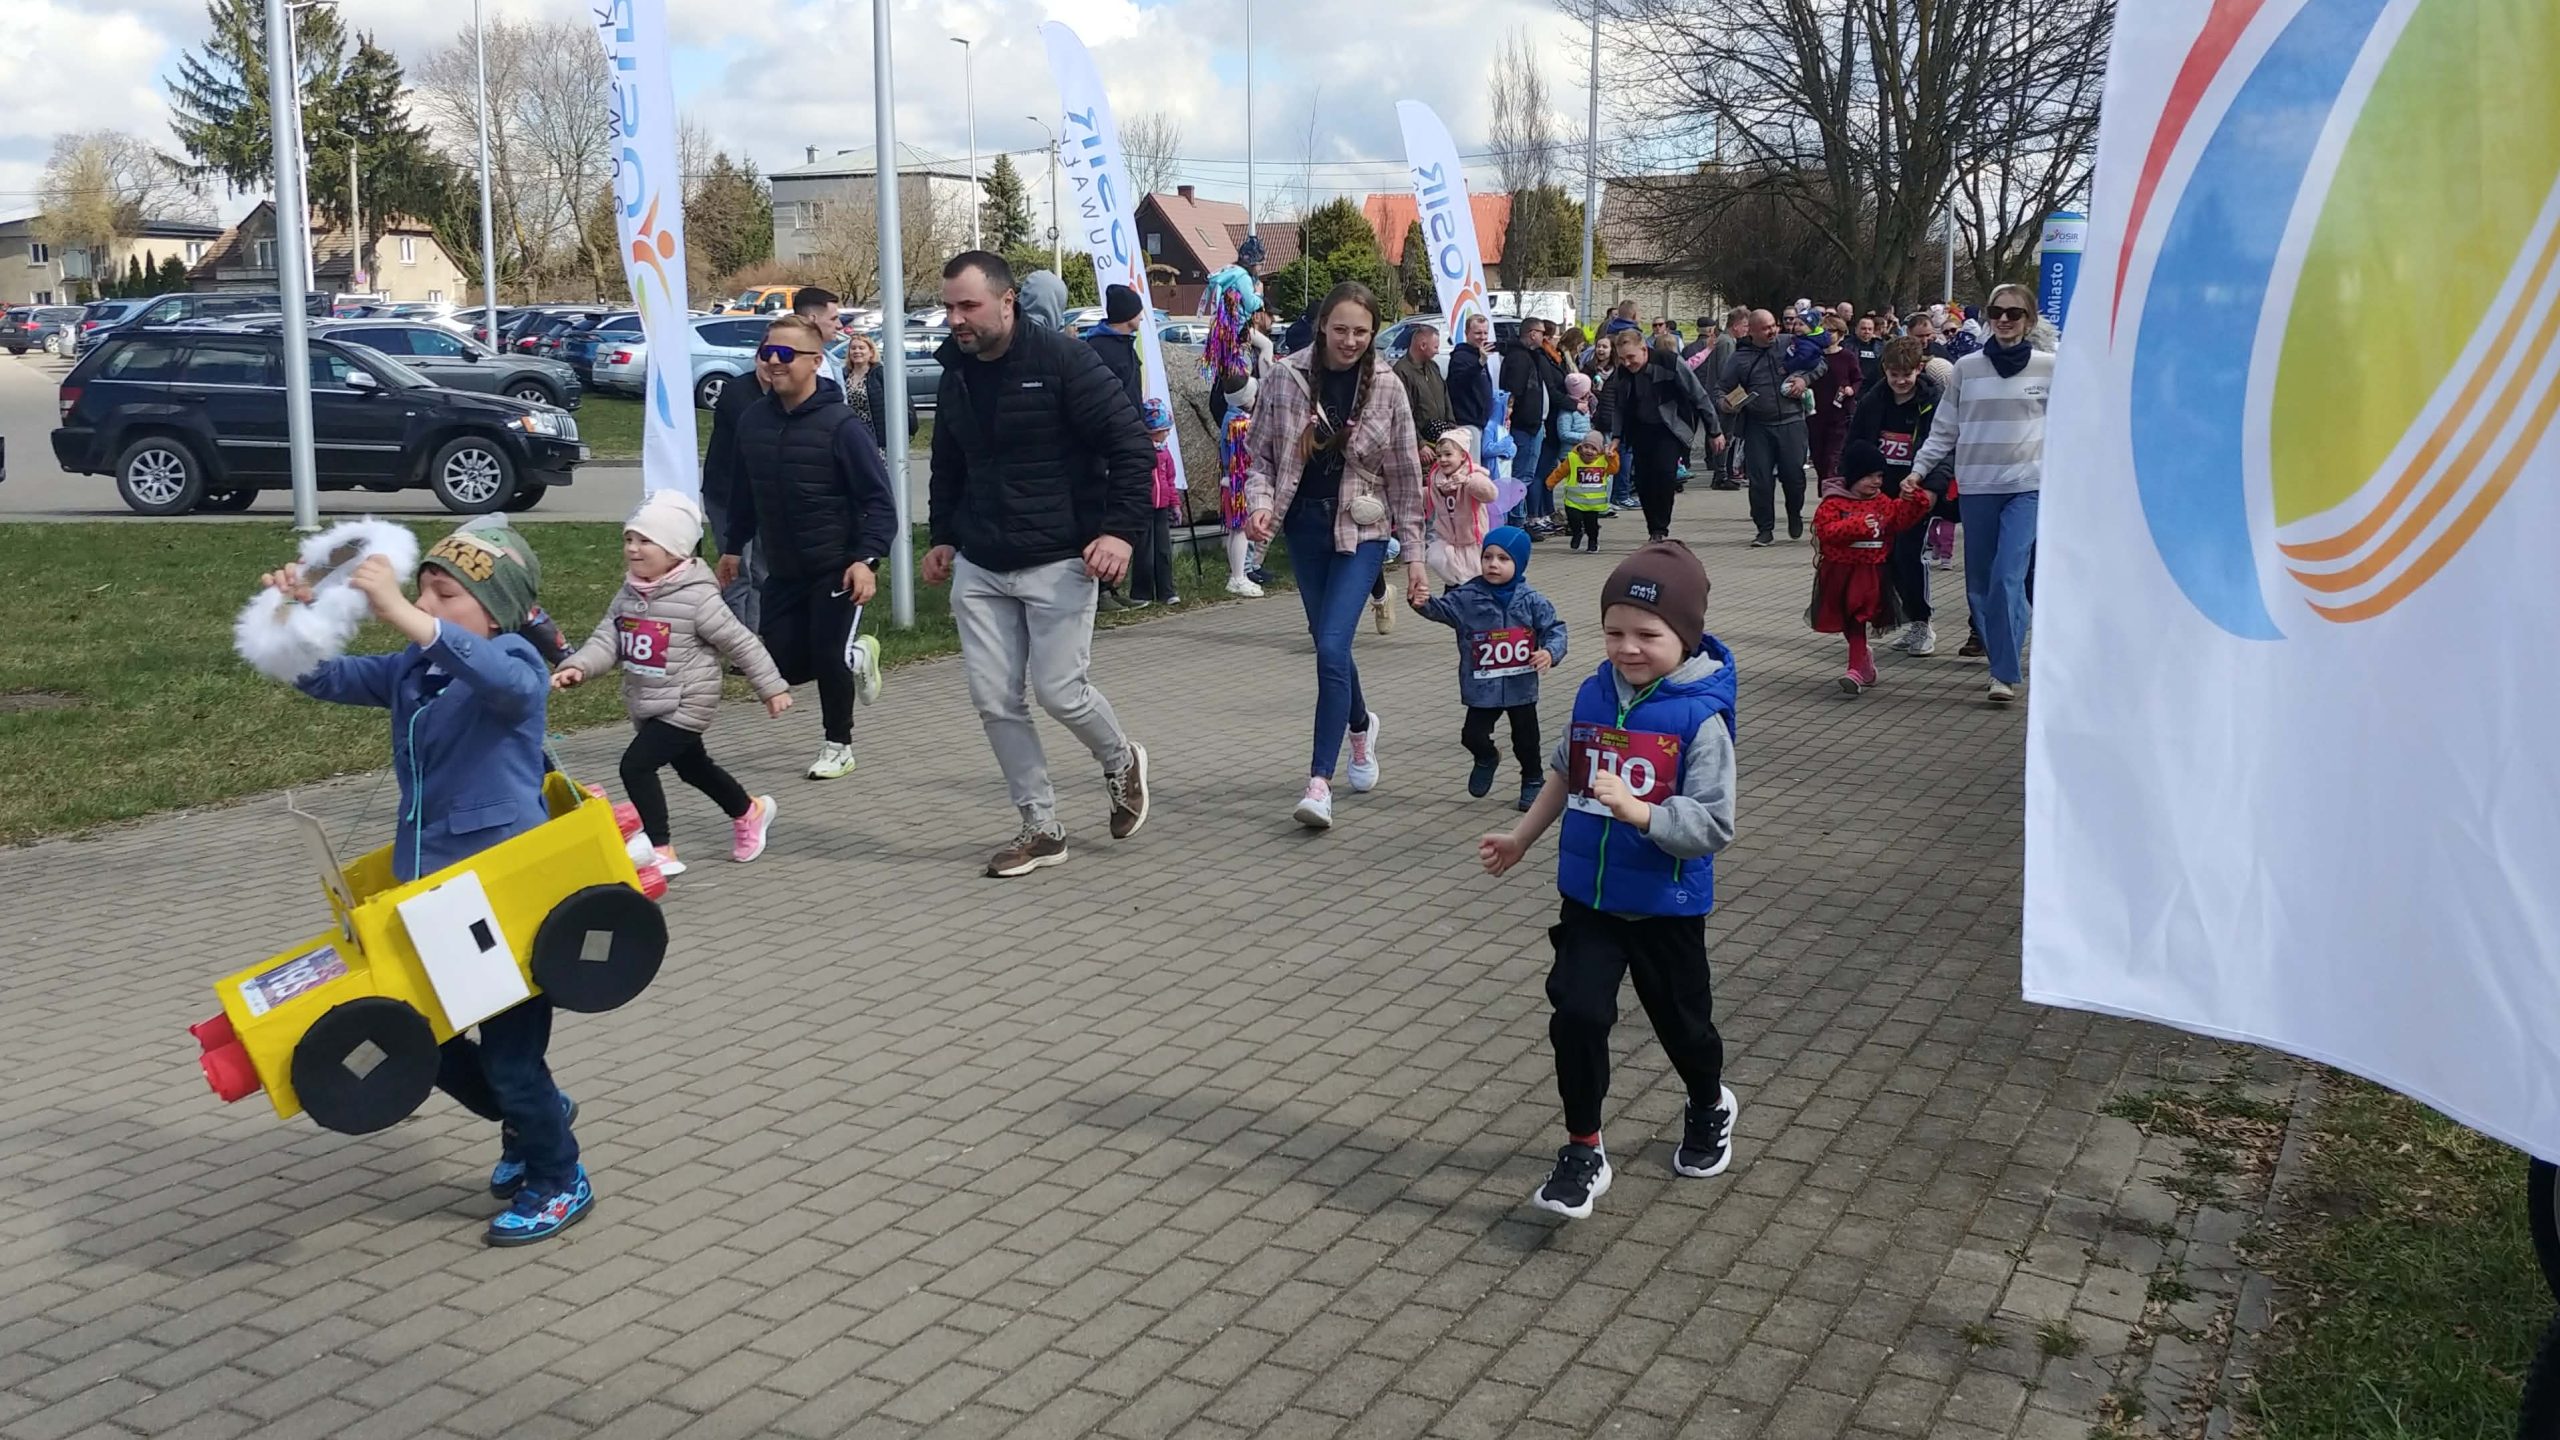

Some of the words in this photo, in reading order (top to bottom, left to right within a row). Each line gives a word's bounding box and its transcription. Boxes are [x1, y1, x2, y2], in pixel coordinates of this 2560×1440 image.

[1879, 438, 1909, 457] 275
[1580, 472, 1601, 483] 146
[620, 631, 653, 660] 118
[1478, 639, 1530, 666] 206
[1585, 748, 1656, 797] 110
